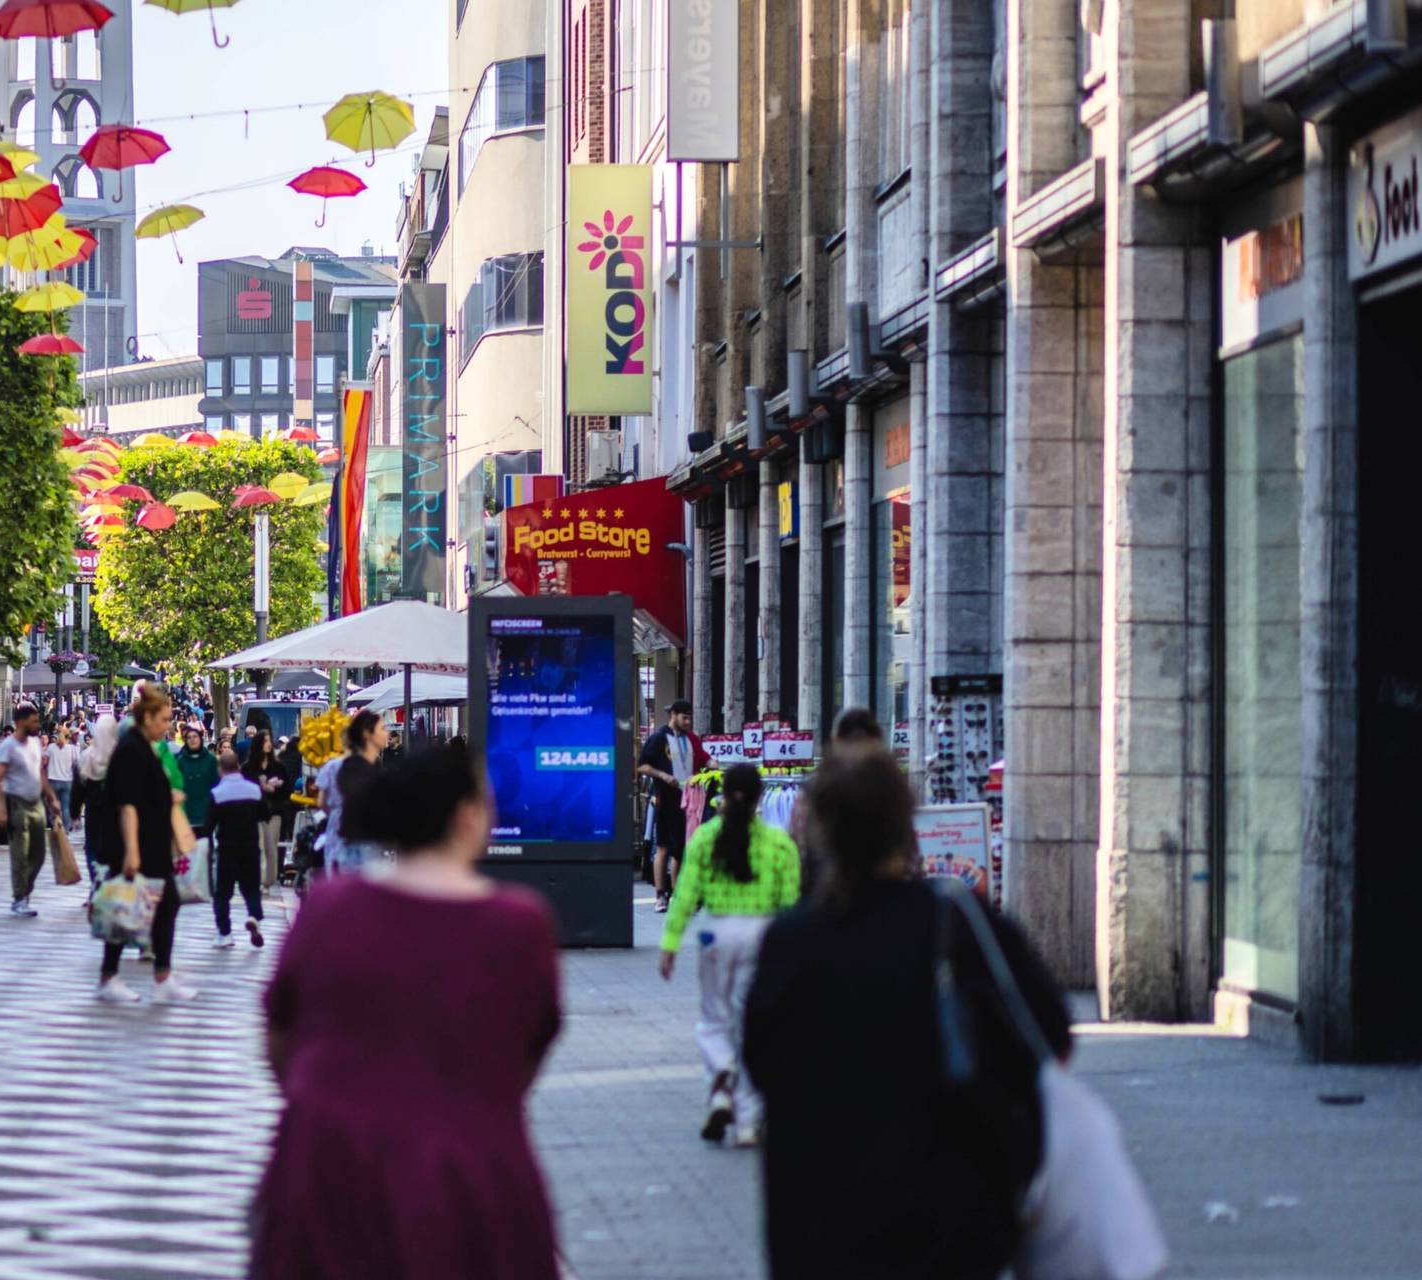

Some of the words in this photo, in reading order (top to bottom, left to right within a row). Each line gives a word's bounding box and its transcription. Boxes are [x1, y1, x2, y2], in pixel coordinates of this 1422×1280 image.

[409, 323, 440, 550] PRIMARK
[514, 522, 574, 554] Food
[579, 521, 650, 555] Store
[537, 549, 578, 559] Bratwurst
[586, 548, 631, 560] Currywurst
[509, 694, 528, 703] viele
[529, 693, 547, 703] Pkw
[549, 693, 567, 703] sind
[568, 694, 576, 703] in
[491, 706, 548, 716] Gelsenkirchen
[550, 706, 593, 717] gemeldet?
[540, 751, 609, 766] 124.445
